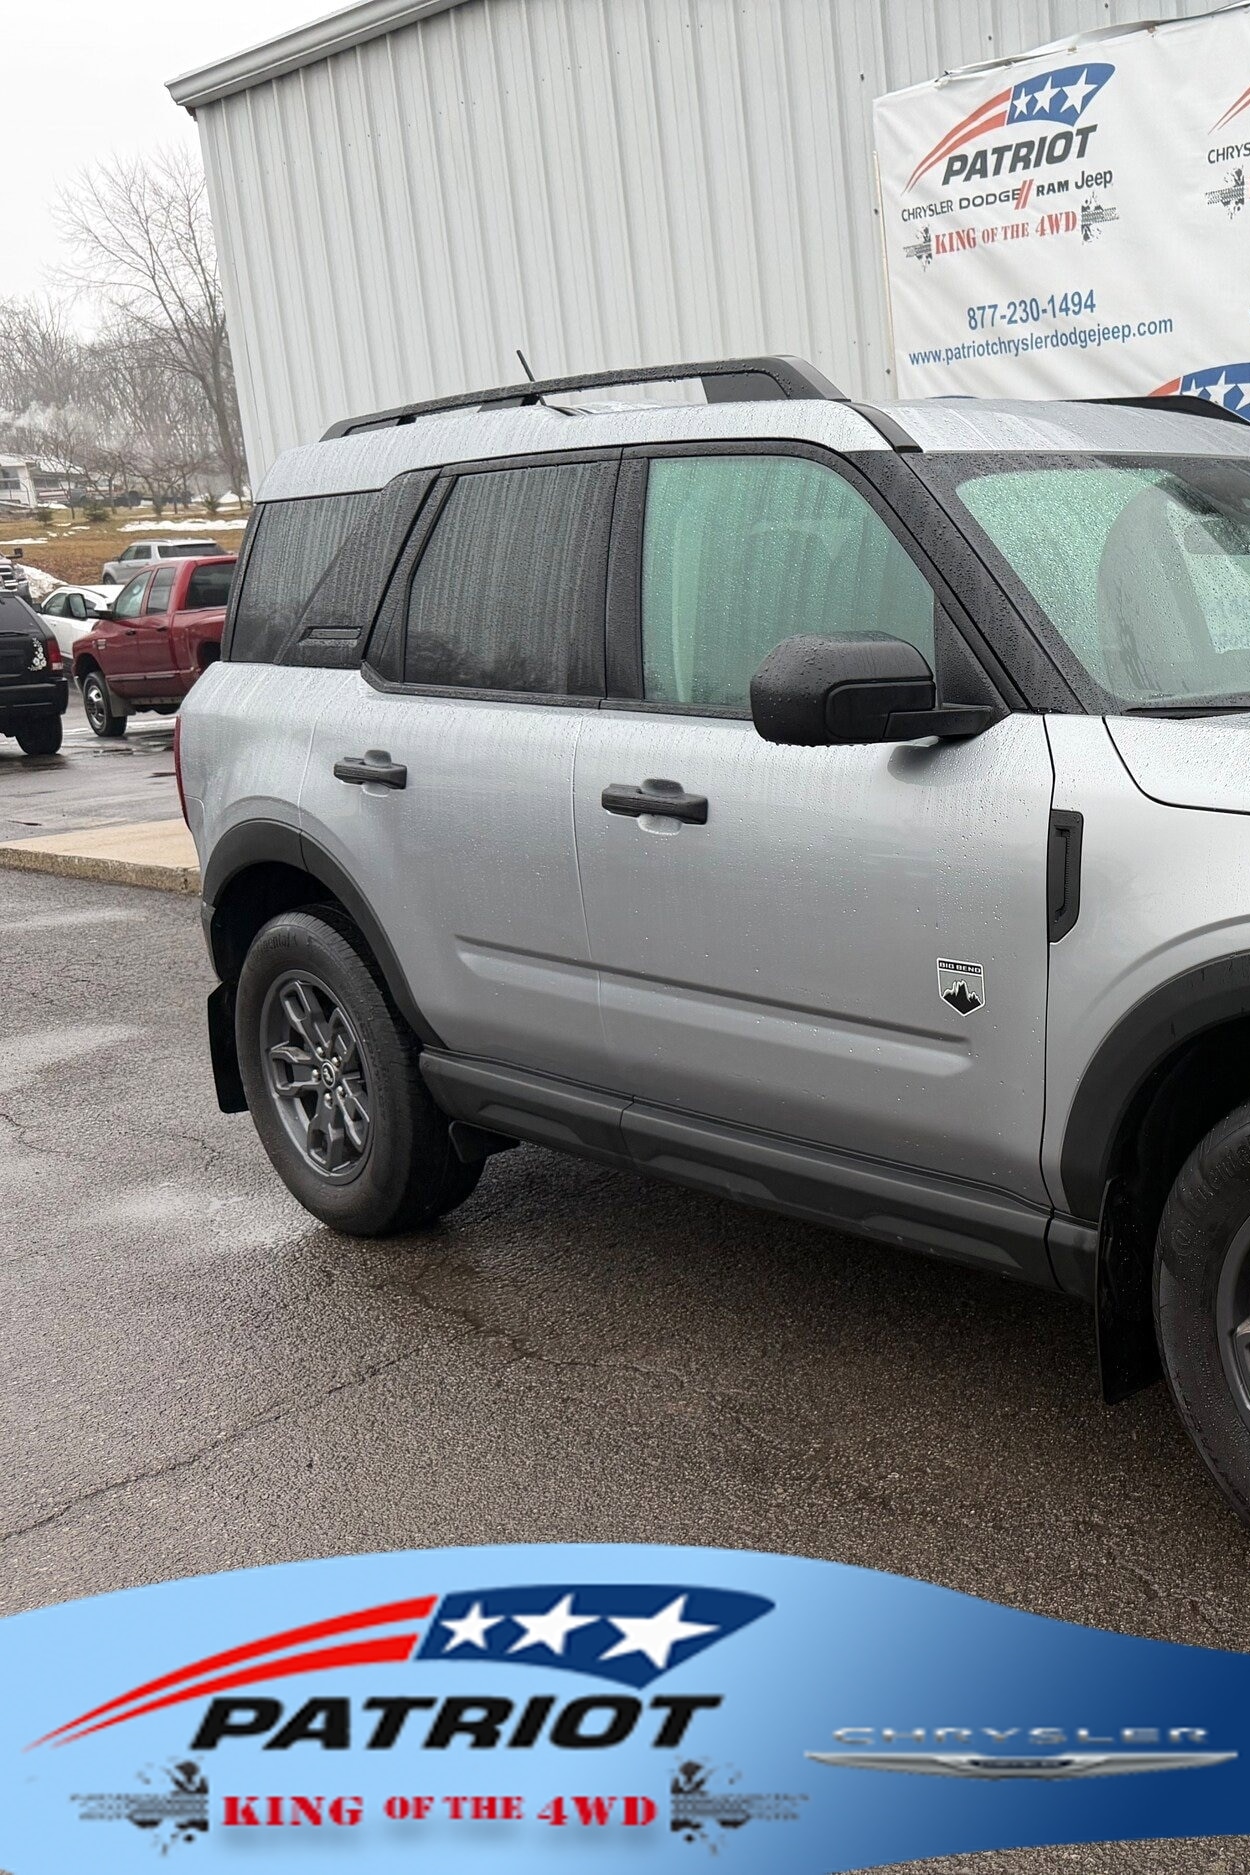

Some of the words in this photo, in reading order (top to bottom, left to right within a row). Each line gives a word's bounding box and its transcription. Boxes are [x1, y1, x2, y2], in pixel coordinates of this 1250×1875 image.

[941, 124, 1098, 186] PATRIOT
[901, 200, 953, 222] CHRYSLER
[959, 188, 1022, 210] DODGE
[1036, 180, 1069, 197] RAM
[1075, 170, 1113, 190] Jeep
[935, 228, 977, 255] KING
[982, 227, 998, 243] OF
[1001, 222, 1030, 240] THE
[1035, 211, 1077, 238] 4WD
[967, 289, 1096, 330] 877-230-1494
[908, 317, 1173, 365] www.patriotchryslerdodgejeep.com
[956, 965, 981, 973] BEND
